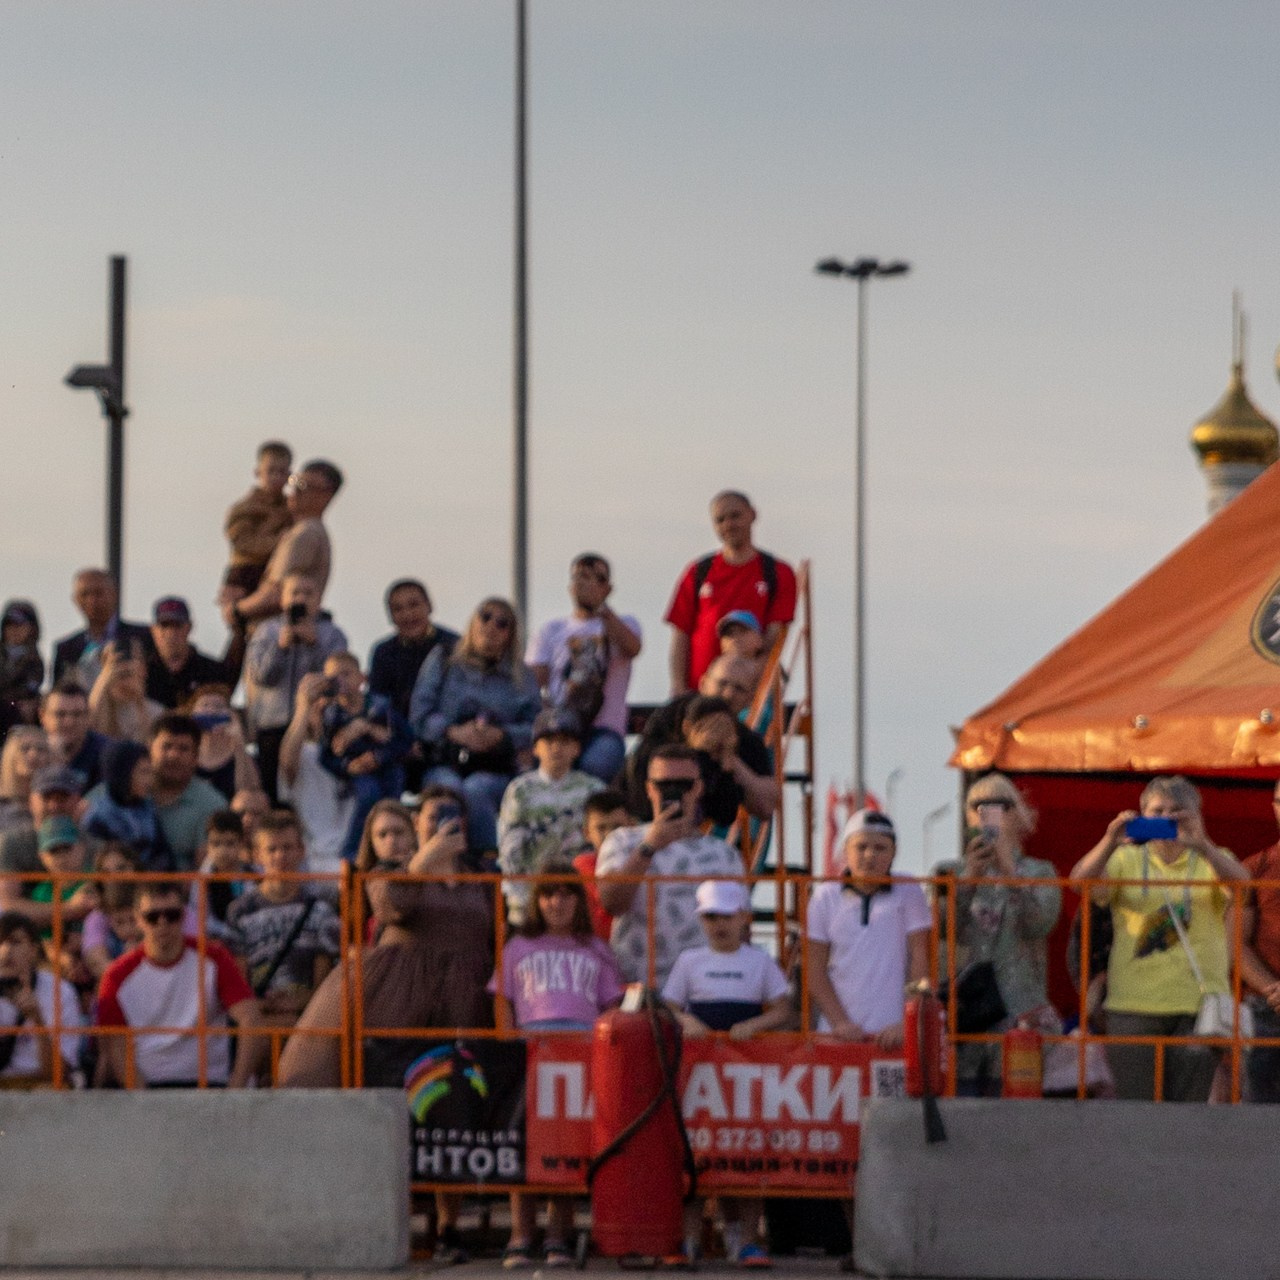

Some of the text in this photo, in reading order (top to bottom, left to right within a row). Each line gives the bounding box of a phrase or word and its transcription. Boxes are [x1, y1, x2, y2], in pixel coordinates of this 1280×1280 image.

[515, 949, 601, 1003] TOKYO
[537, 1062, 860, 1122] ПАТКИ
[415, 1128, 520, 1144] ПОРАЦИЯ
[416, 1146, 520, 1178] НТОВ
